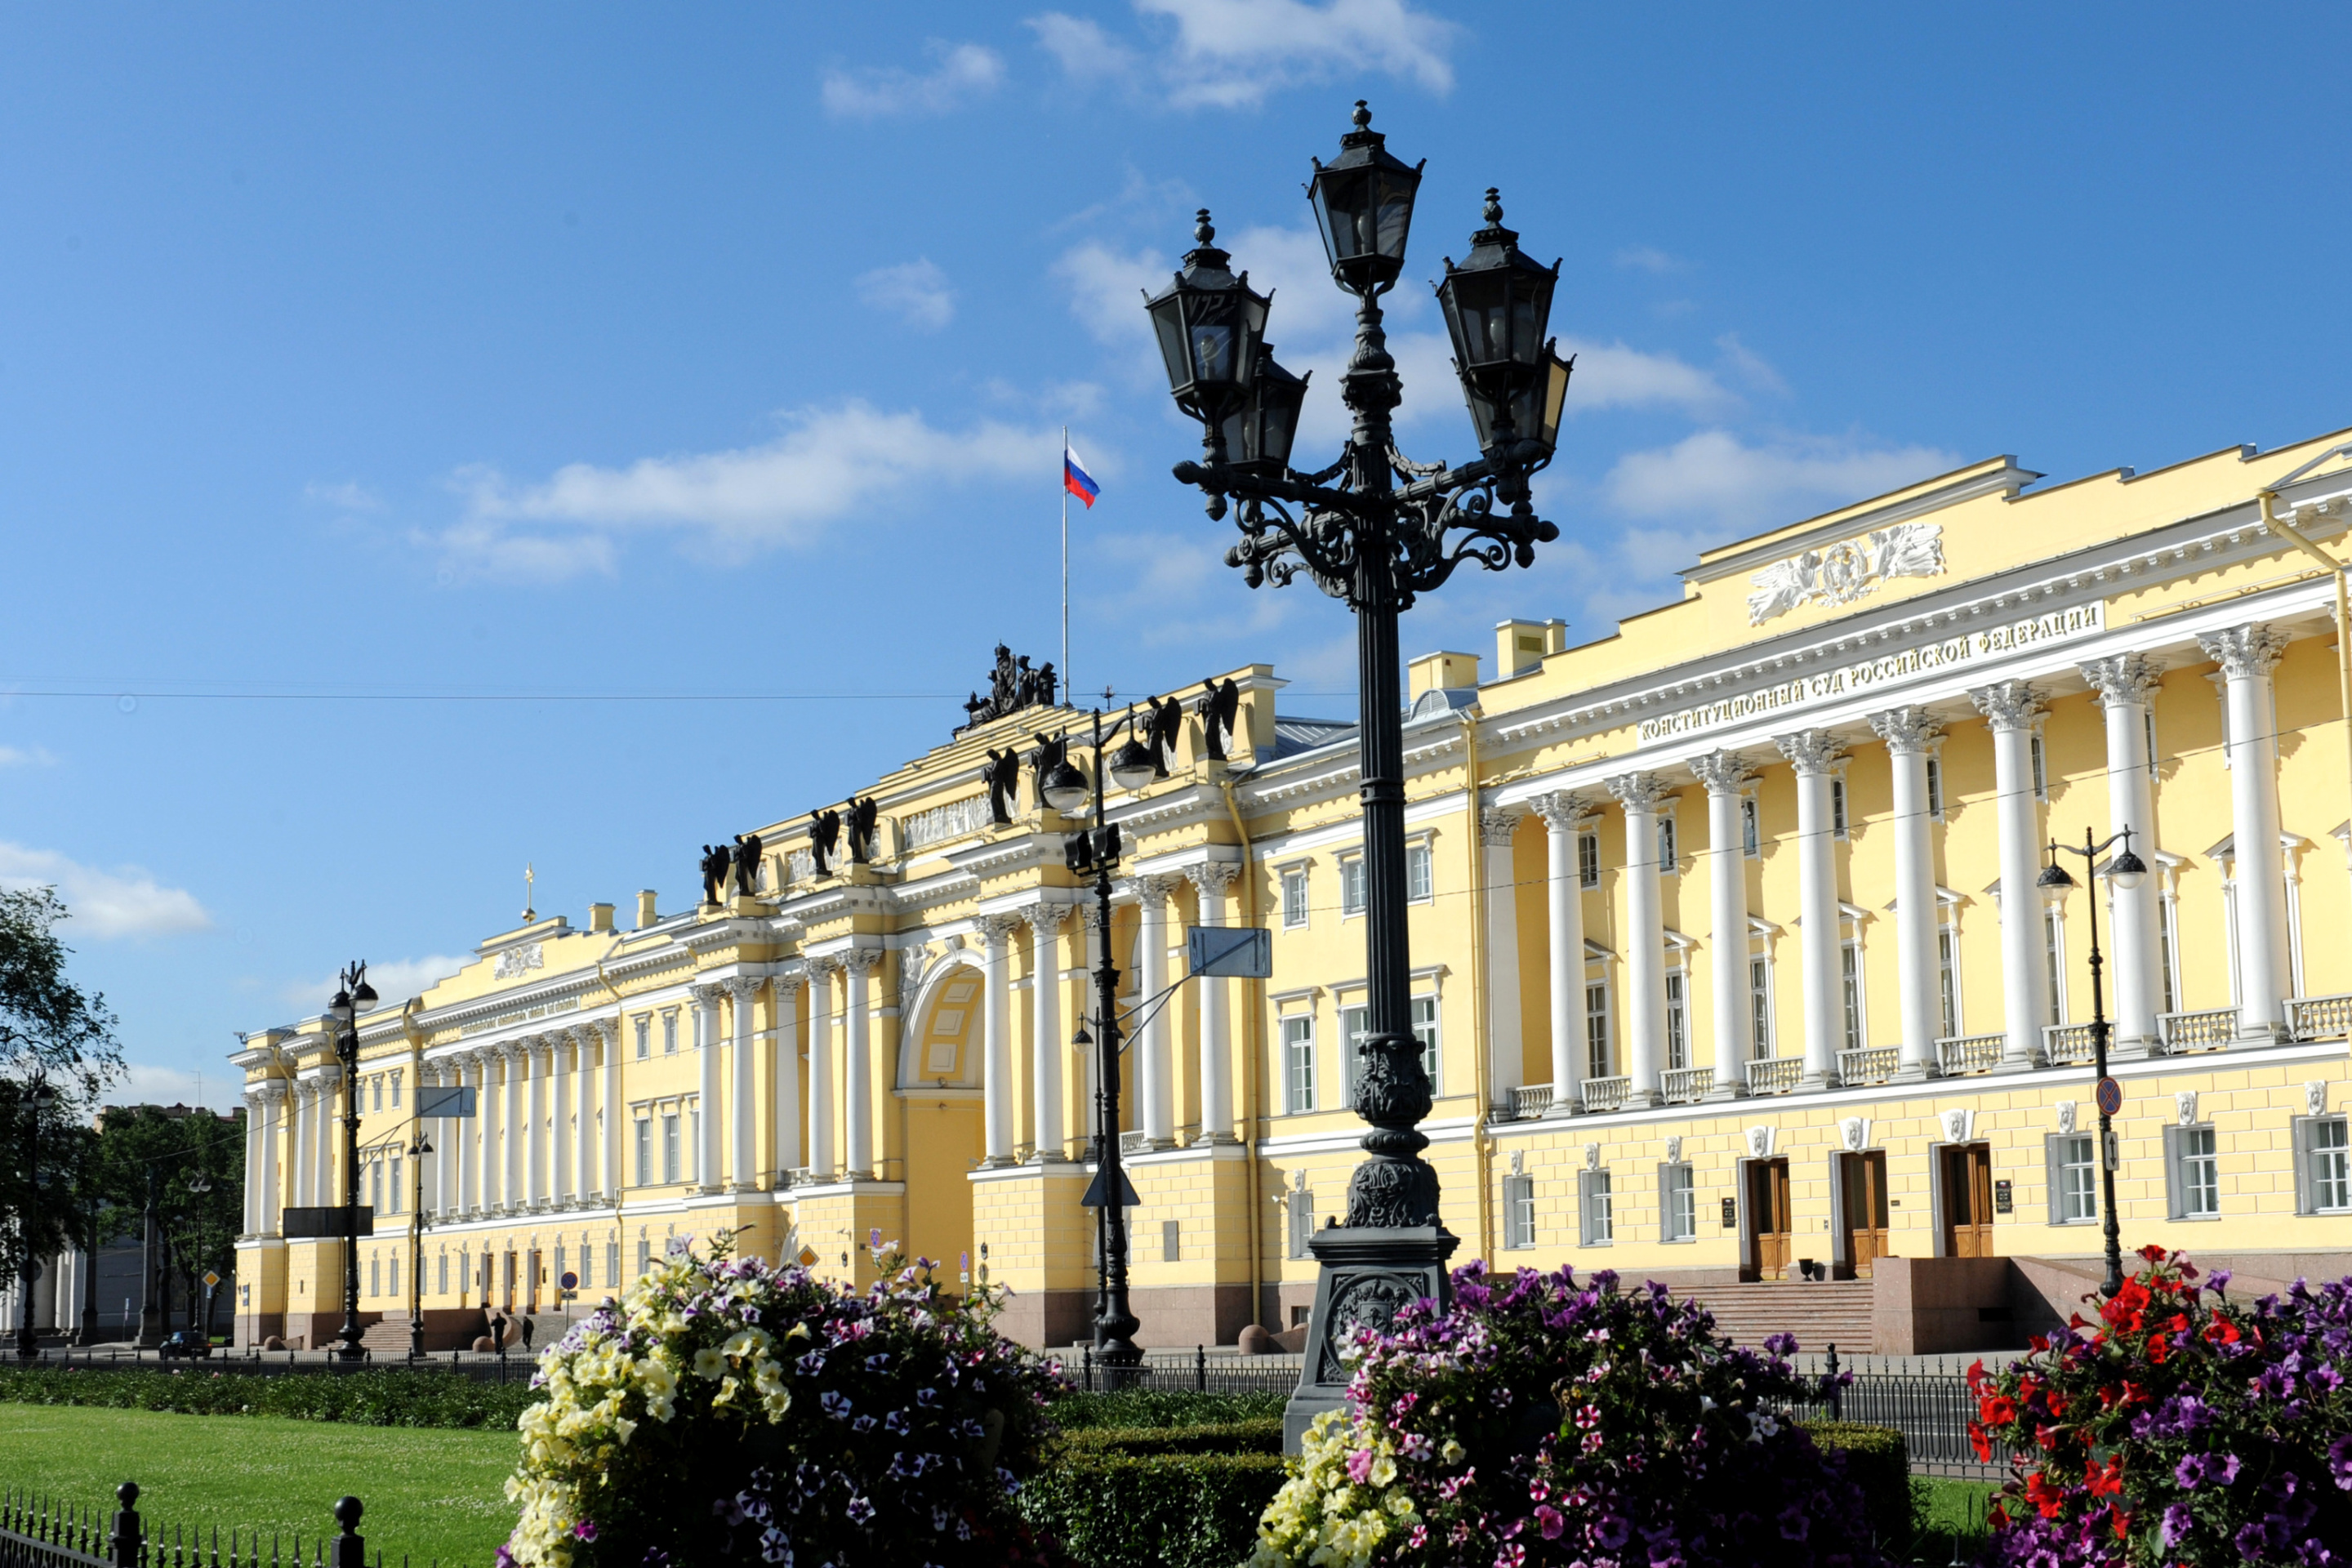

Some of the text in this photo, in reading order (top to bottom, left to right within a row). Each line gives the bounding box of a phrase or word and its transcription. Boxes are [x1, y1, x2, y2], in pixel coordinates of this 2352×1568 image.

[1642, 607, 2097, 740] КОНСТИТУЦИОННЫЙ СУД РОССИЙСКОЙ ФЕДЕРАЦИИ
